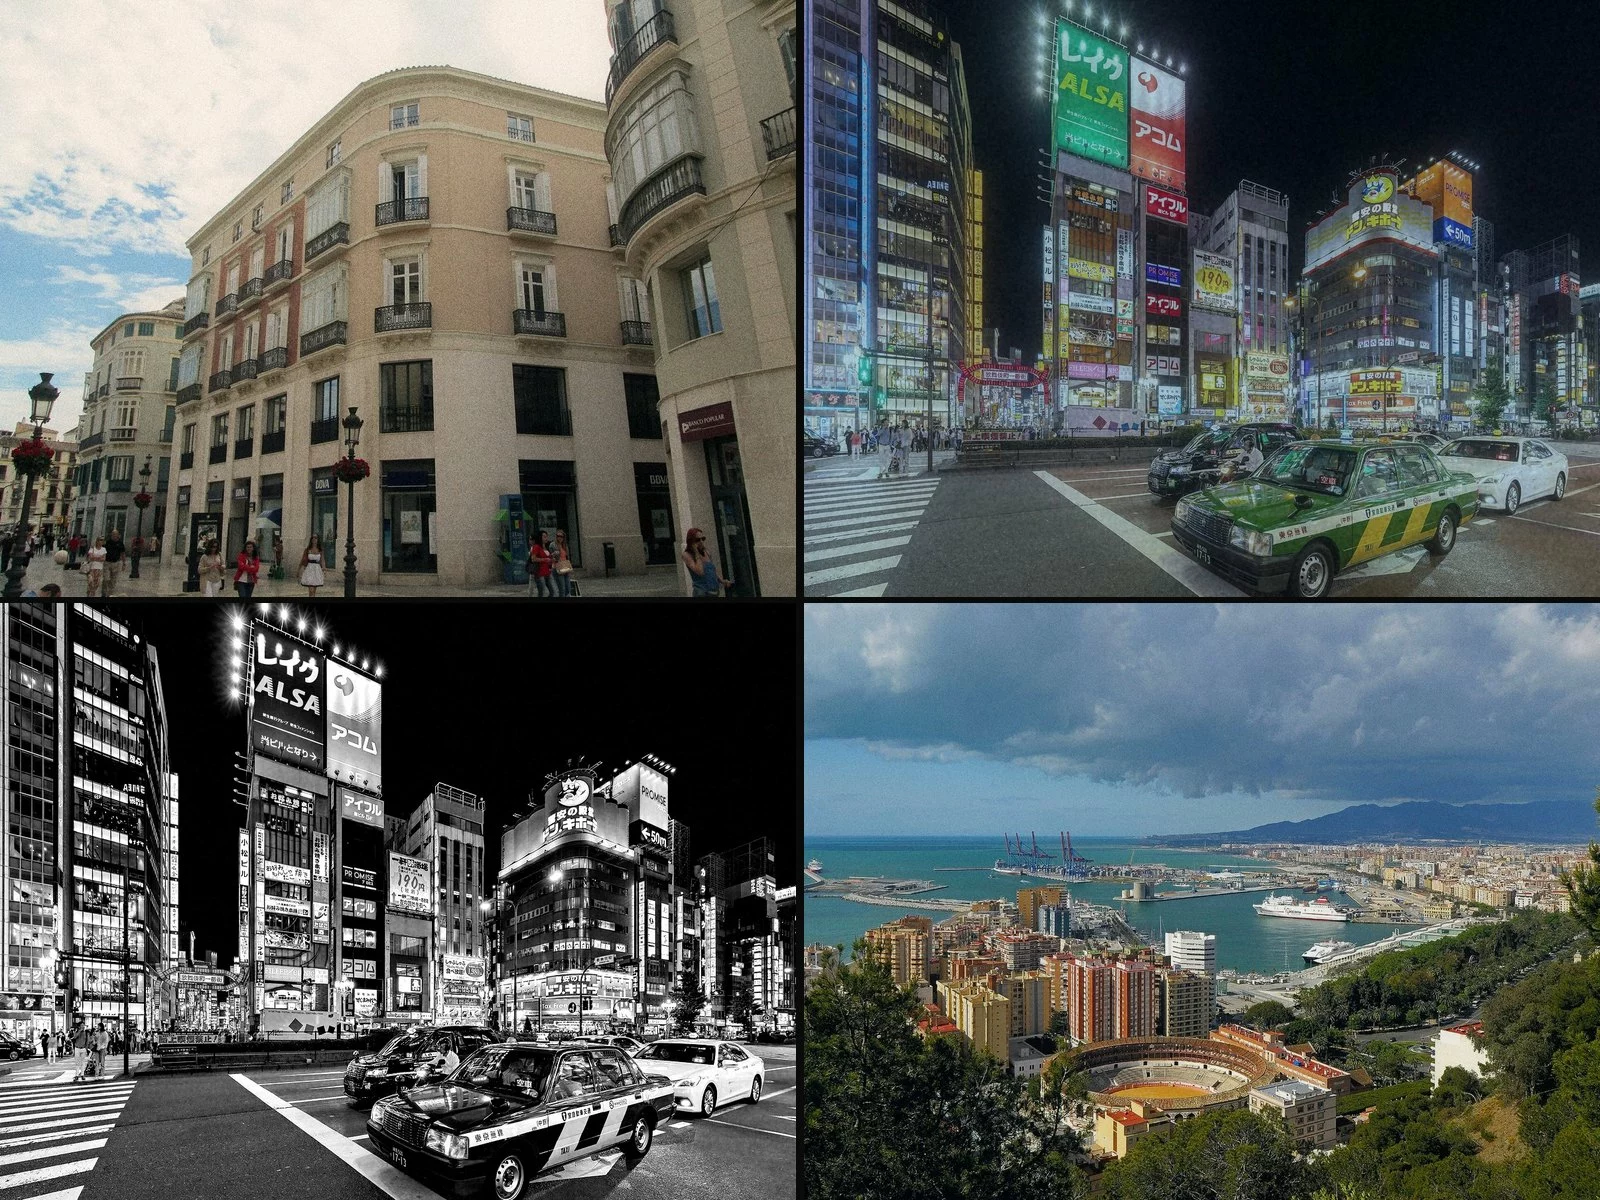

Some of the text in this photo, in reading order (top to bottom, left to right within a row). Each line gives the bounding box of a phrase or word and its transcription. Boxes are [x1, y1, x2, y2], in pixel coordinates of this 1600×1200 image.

[1061, 30, 1123, 81] レイク
[1059, 71, 1125, 113] ALSA
[1135, 120, 1181, 153] アコム
[1148, 191, 1186, 213] アイフル
[1445, 182, 1471, 204] PROMISE
[1454, 227, 1472, 245] 50m
[1045, 235, 1053, 275] 小松ビル
[1148, 266, 1178, 280] PROMISE
[1201, 270, 1230, 290] 190円
[1147, 295, 1179, 311] アイフル
[1147, 358, 1179, 370] アコム
[688, 413, 725, 427] BANCO POPULAR
[257, 633, 319, 684] レイク
[255, 674, 321, 716] ALSA
[331, 722, 378, 756] アコム
[344, 794, 382, 817] アイフル
[641, 785, 667, 807] PROMISE
[650, 830, 667, 848] 50m
[240, 838, 249, 878] 小松ビル
[344, 869, 375, 881] PROMISE
[397, 873, 425, 892] 190円
[343, 899, 375, 914] アイフル
[343, 961, 375, 973] アコム
